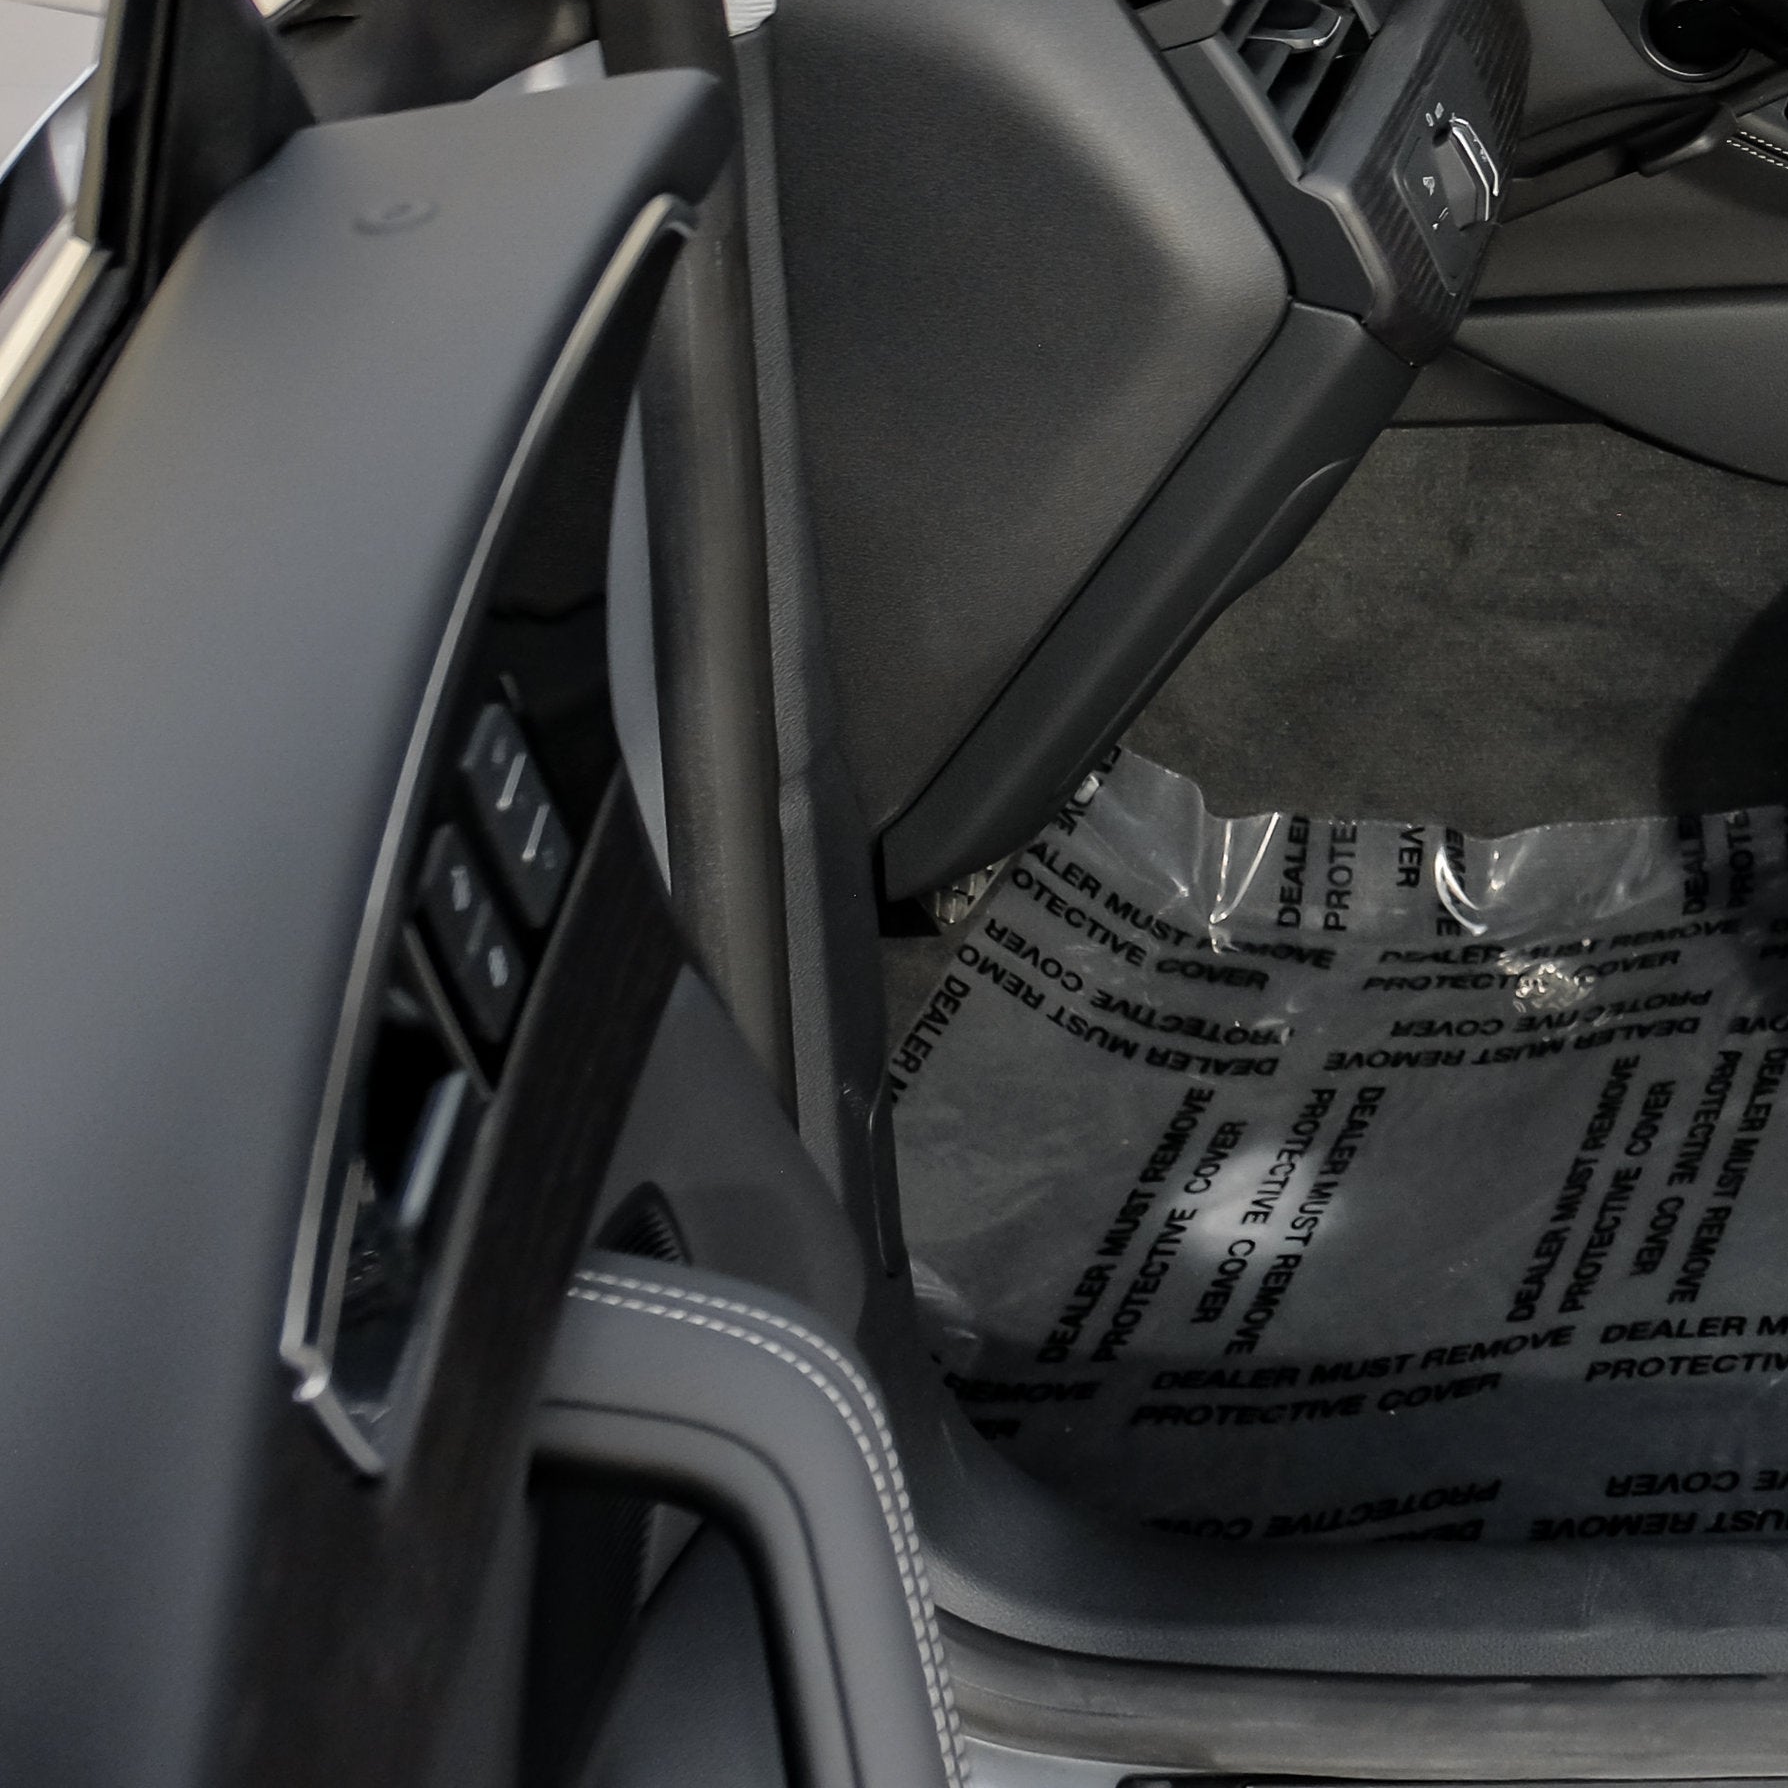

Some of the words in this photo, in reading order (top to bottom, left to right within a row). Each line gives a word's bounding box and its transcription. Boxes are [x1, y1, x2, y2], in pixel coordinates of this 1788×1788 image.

[1277, 815, 1311, 929] DEALE
[1323, 824, 1357, 932] PROTE
[1396, 826, 1425, 888] VER
[1677, 813, 1710, 915] DEALE
[1011, 868, 1147, 967] OTECTIVE
[1156, 959, 1270, 991] COVER
[1027, 842, 1101, 898] ALER
[1104, 893, 1192, 947] MUST
[957, 943, 1046, 1011] REMO
[985, 918, 1084, 994] COVER
[1378, 944, 1505, 965] DEALER
[1609, 918, 1743, 950] REMOVE
[1361, 969, 1527, 992] PROTECT
[891, 974, 971, 1074] DEALER
[1047, 1005, 1140, 1060] MUST
[1145, 1041, 1280, 1076] DEALER
[1322, 1049, 1465, 1071] REMOVE
[1391, 1019, 1504, 1038] COVER
[1471, 1038, 1565, 1066] MUST
[1573, 1017, 1700, 1050] DEALER
[1319, 1085, 1386, 1178] DEALER
[1665, 1049, 1743, 1187] PROTECTIVE
[1241, 1087, 1338, 1226] PROTECTIVE
[1505, 1225, 1573, 1324] DEALER
[1550, 1156, 1599, 1224] MUST
[1580, 1053, 1641, 1153] REMOVE
[1711, 1136, 1760, 1201] MUST
[1037, 1262, 1117, 1364] DEALER
[1098, 1188, 1156, 1257] MUST
[1140, 1085, 1214, 1184] REMOVE
[1285, 1180, 1339, 1248] MUST
[1557, 1166, 1642, 1315] PROTECTIVE
[1624, 1078, 1677, 1158] COVER
[1090, 1207, 1197, 1363] PROTECTIVE
[1183, 1120, 1248, 1195] COVER
[1630, 1195, 1685, 1276] COVER
[1665, 1205, 1733, 1306] REMOVE
[1190, 1238, 1256, 1324] COVER
[1224, 1253, 1303, 1357] REMOVE
[1149, 1366, 1301, 1390] DEALER
[1308, 1353, 1416, 1385] MUST
[1420, 1324, 1578, 1370] REMOVE
[1600, 1315, 1748, 1344] DEALER
[1129, 1393, 1367, 1426] PROTECTIVE
[1376, 1372, 1503, 1412] COVER
[1263, 1478, 1503, 1538] PROTECTIVE
[1605, 1469, 1740, 1498] COVER
[1528, 1512, 1699, 1543] REMOVE
